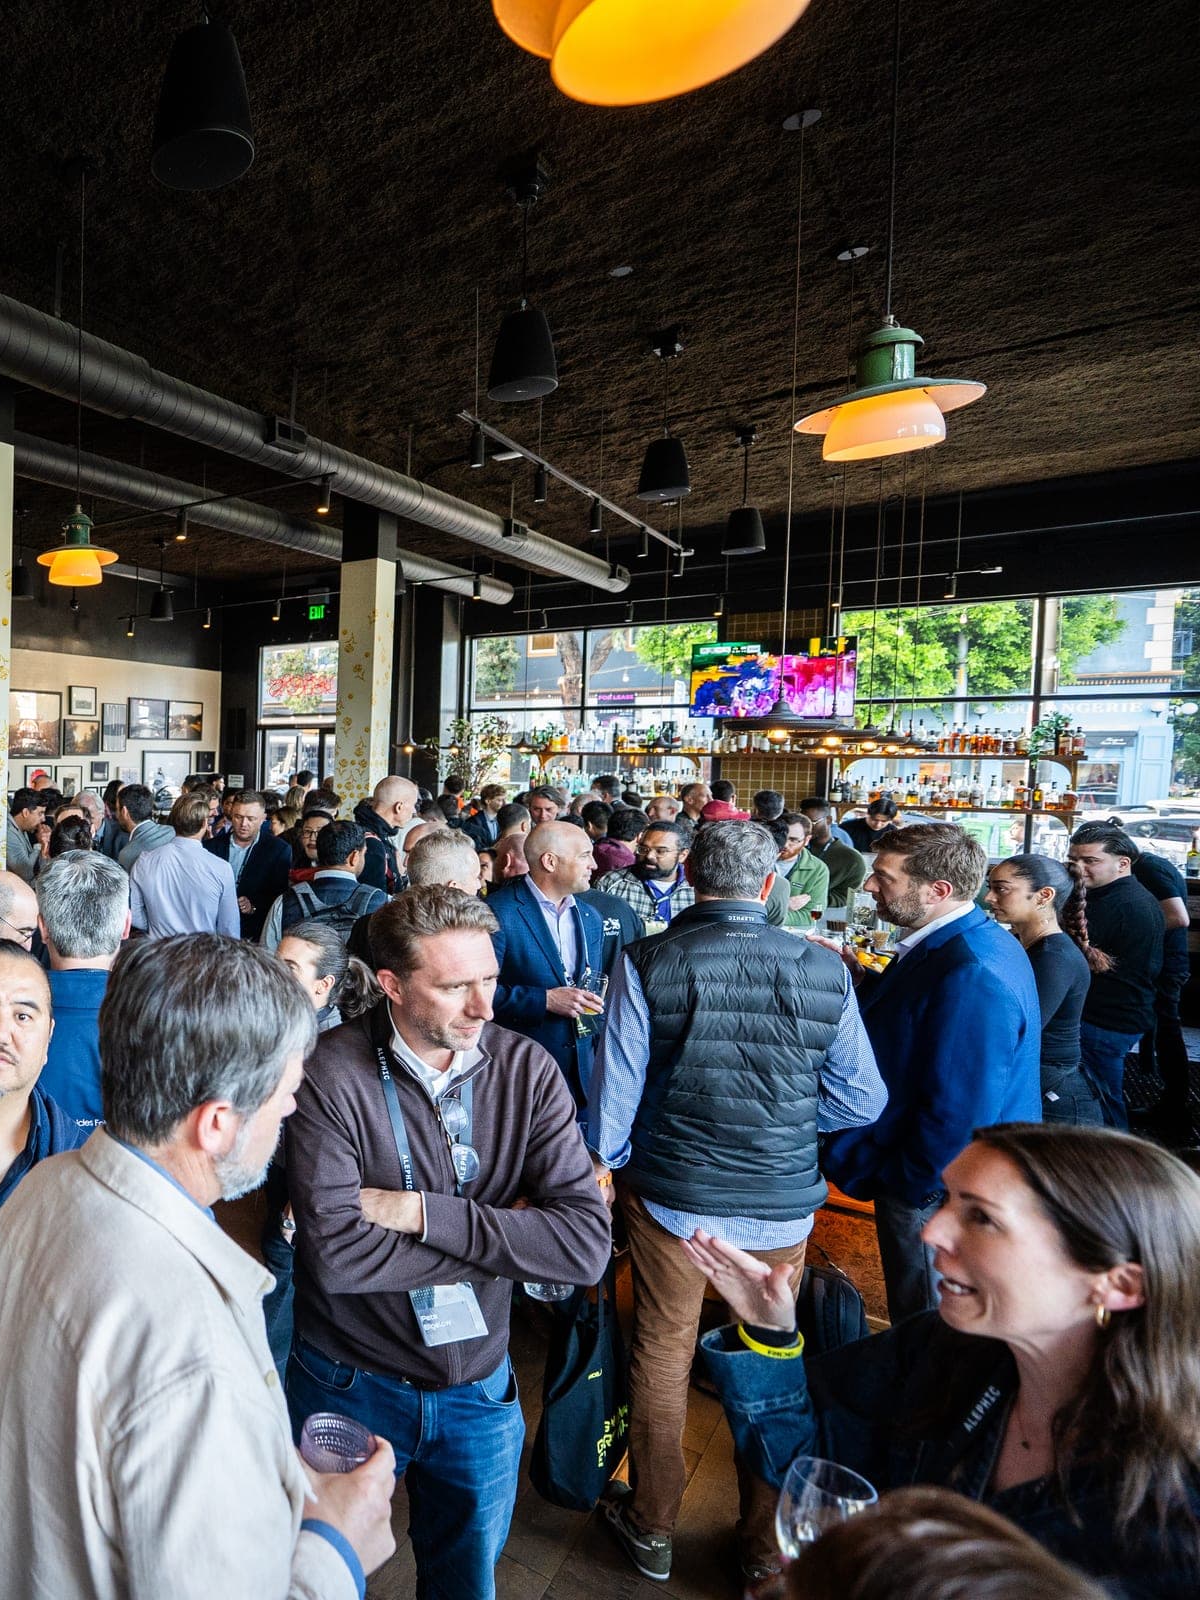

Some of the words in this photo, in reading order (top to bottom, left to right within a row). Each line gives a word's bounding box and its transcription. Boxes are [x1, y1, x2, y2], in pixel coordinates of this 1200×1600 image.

[309, 605, 325, 620] EXIT
[376, 1047, 391, 1081] ALEPHIC
[402, 1154, 413, 1191] ALEPHIC
[963, 1385, 1001, 1433] ALEPHIC
